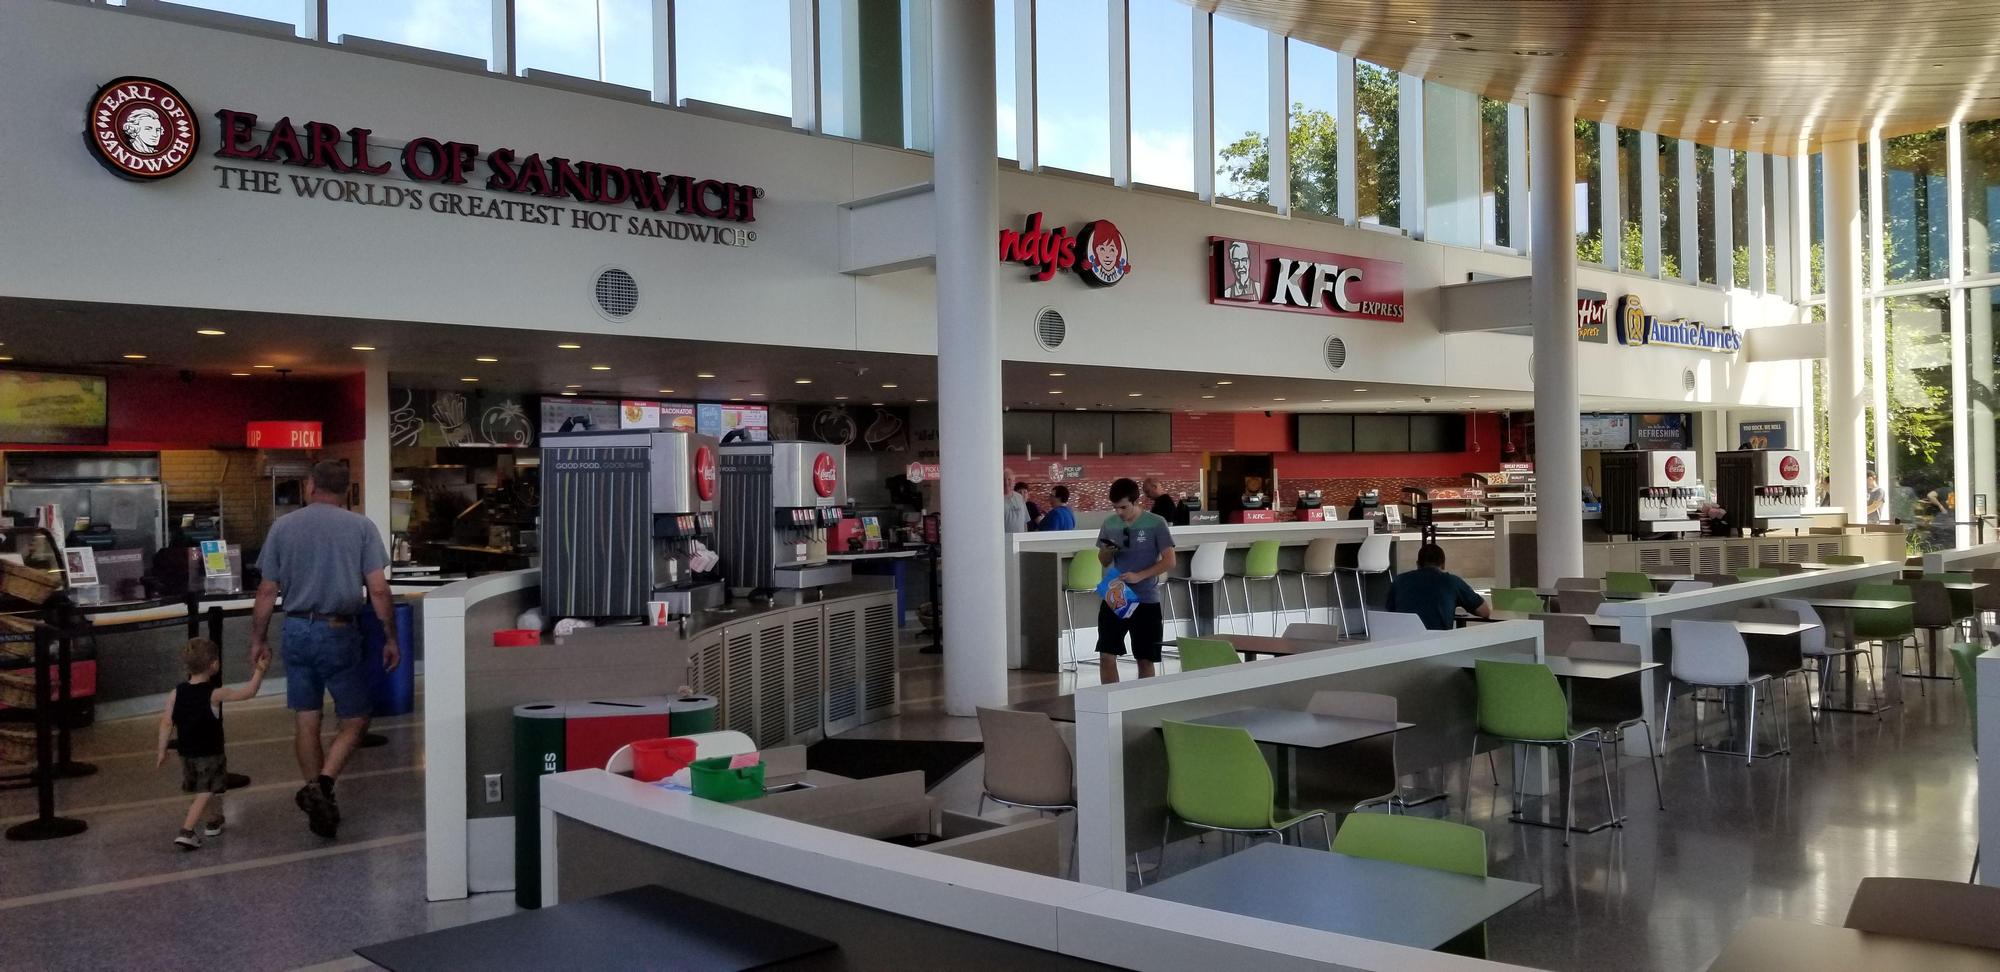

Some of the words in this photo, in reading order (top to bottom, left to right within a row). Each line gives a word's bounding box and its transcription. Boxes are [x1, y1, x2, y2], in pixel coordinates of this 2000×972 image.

[103, 85, 155, 112] EARL
[160, 97, 185, 118] OF
[100, 130, 190, 172] SANDWICH
[215, 109, 391, 175] EARL
[401, 137, 479, 185] OF
[213, 165, 281, 195] THE
[289, 174, 423, 211] WORLD'S
[429, 191, 565, 227] GREATEST
[571, 209, 623, 233] HOT
[1000, 211, 1076, 282] ndy's
[1271, 257, 1363, 313] KFC
[1362, 300, 1403, 318] EXPRESS
[1579, 298, 1610, 328] Hut
[1651, 317, 1697, 346] Auntie
[1697, 324, 1741, 351] Anne's
[661, 407, 693, 415] BACONATOR
[291, 430, 315, 448] PICK
[1638, 429, 1680, 438] REFRESHING
[555, 462, 578, 470] GOOD
[544, 752, 557, 774] ES
